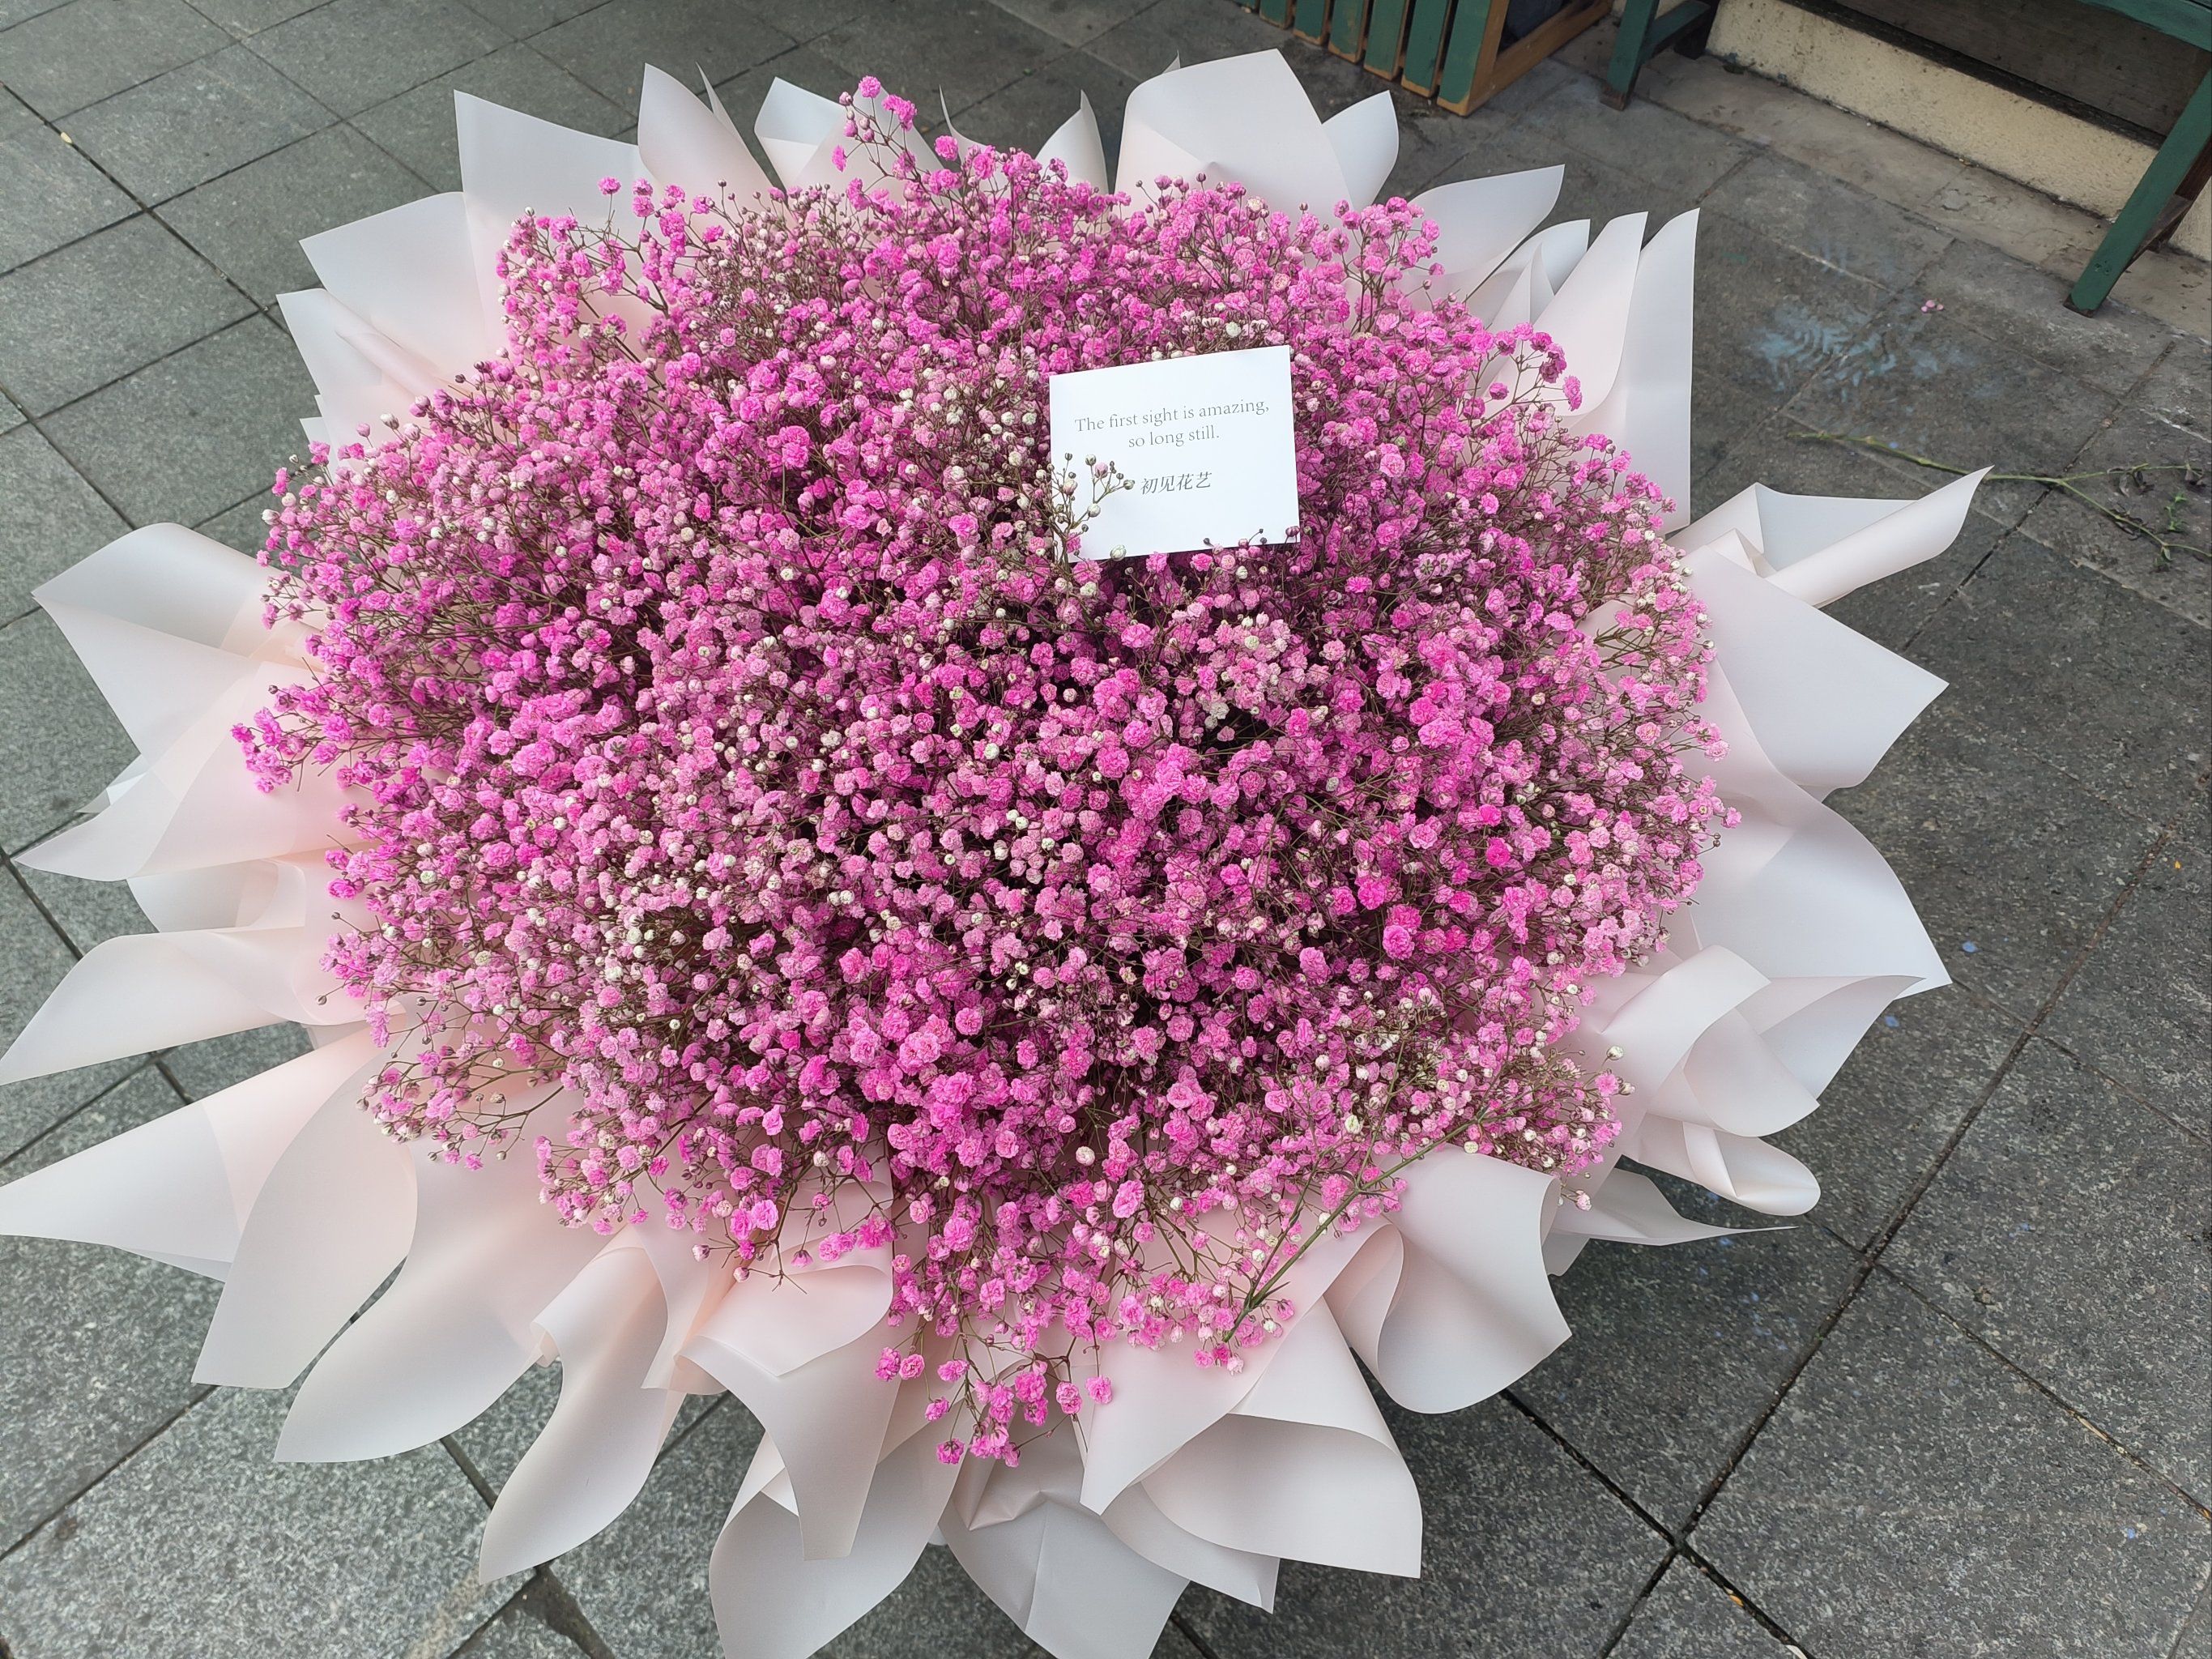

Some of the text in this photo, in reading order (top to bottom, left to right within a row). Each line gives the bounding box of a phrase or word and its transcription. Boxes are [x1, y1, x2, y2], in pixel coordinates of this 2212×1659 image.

[1074, 399, 1269, 432] The first sight is amazing,
[1128, 425, 1220, 447] so long still.
[1140, 471, 1213, 495] 初见花艺
